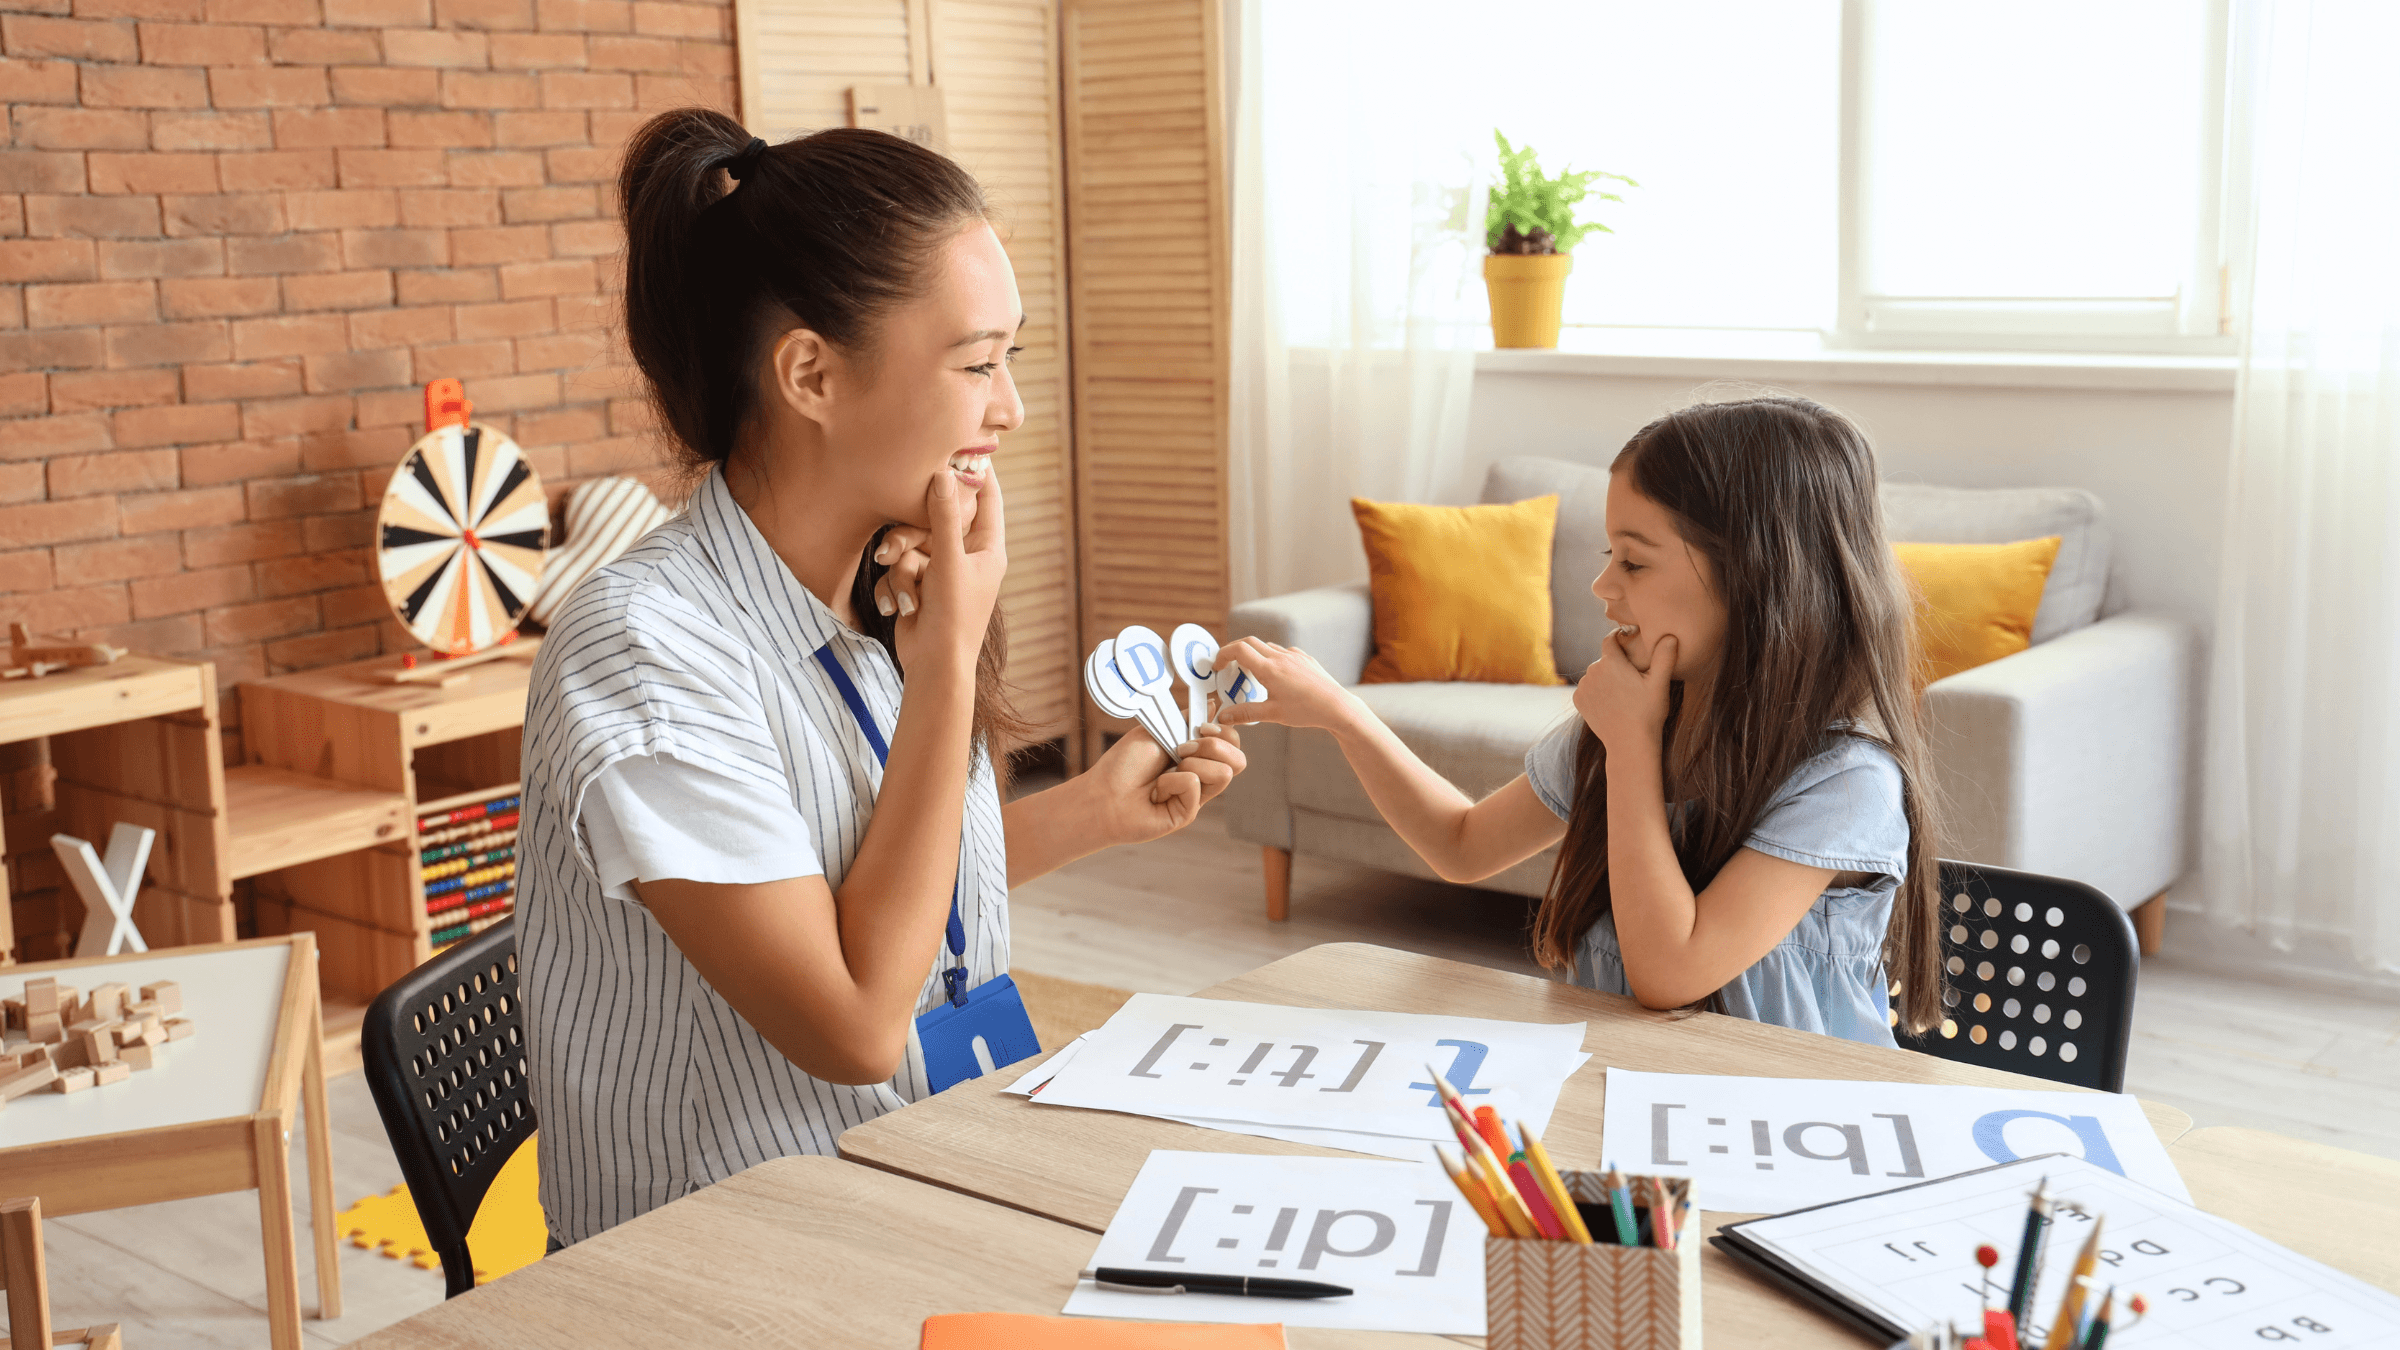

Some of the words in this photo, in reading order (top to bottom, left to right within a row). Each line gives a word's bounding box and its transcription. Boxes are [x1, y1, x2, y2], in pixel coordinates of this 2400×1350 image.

[1124, 642, 1165, 687] D
[1184, 639, 1213, 680] C
[1408, 1038, 1492, 1108] t
